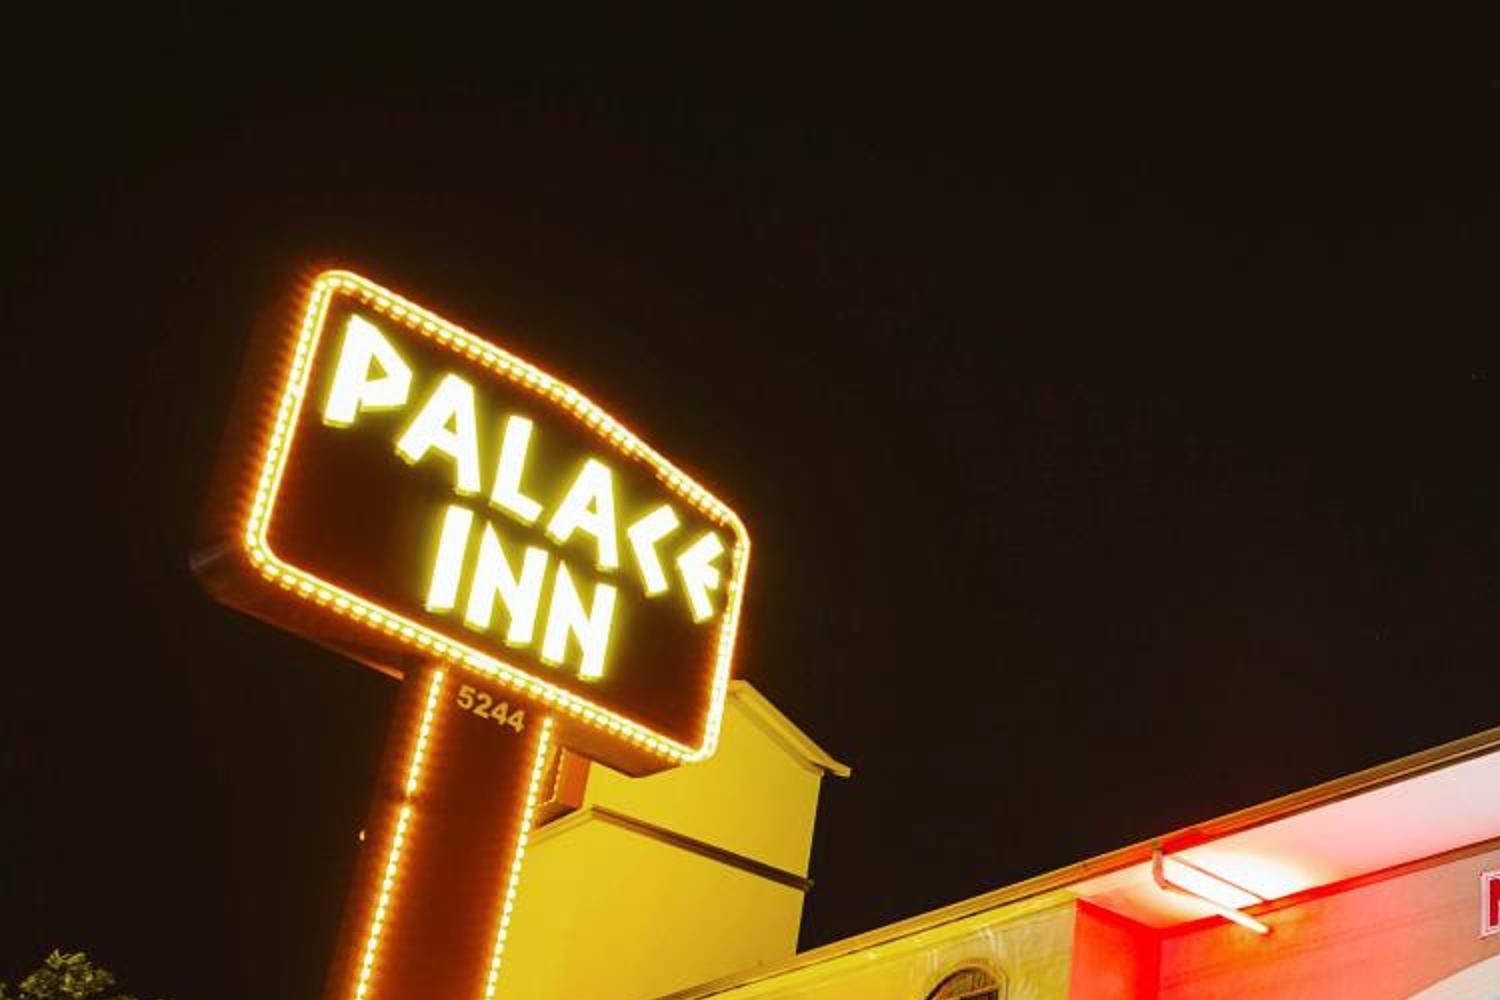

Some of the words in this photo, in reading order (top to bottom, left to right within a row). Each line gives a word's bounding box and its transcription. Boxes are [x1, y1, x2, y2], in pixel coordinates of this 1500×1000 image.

[322, 314, 725, 624] PALACE
[425, 505, 618, 681] INN
[456, 684, 525, 733] 5244
